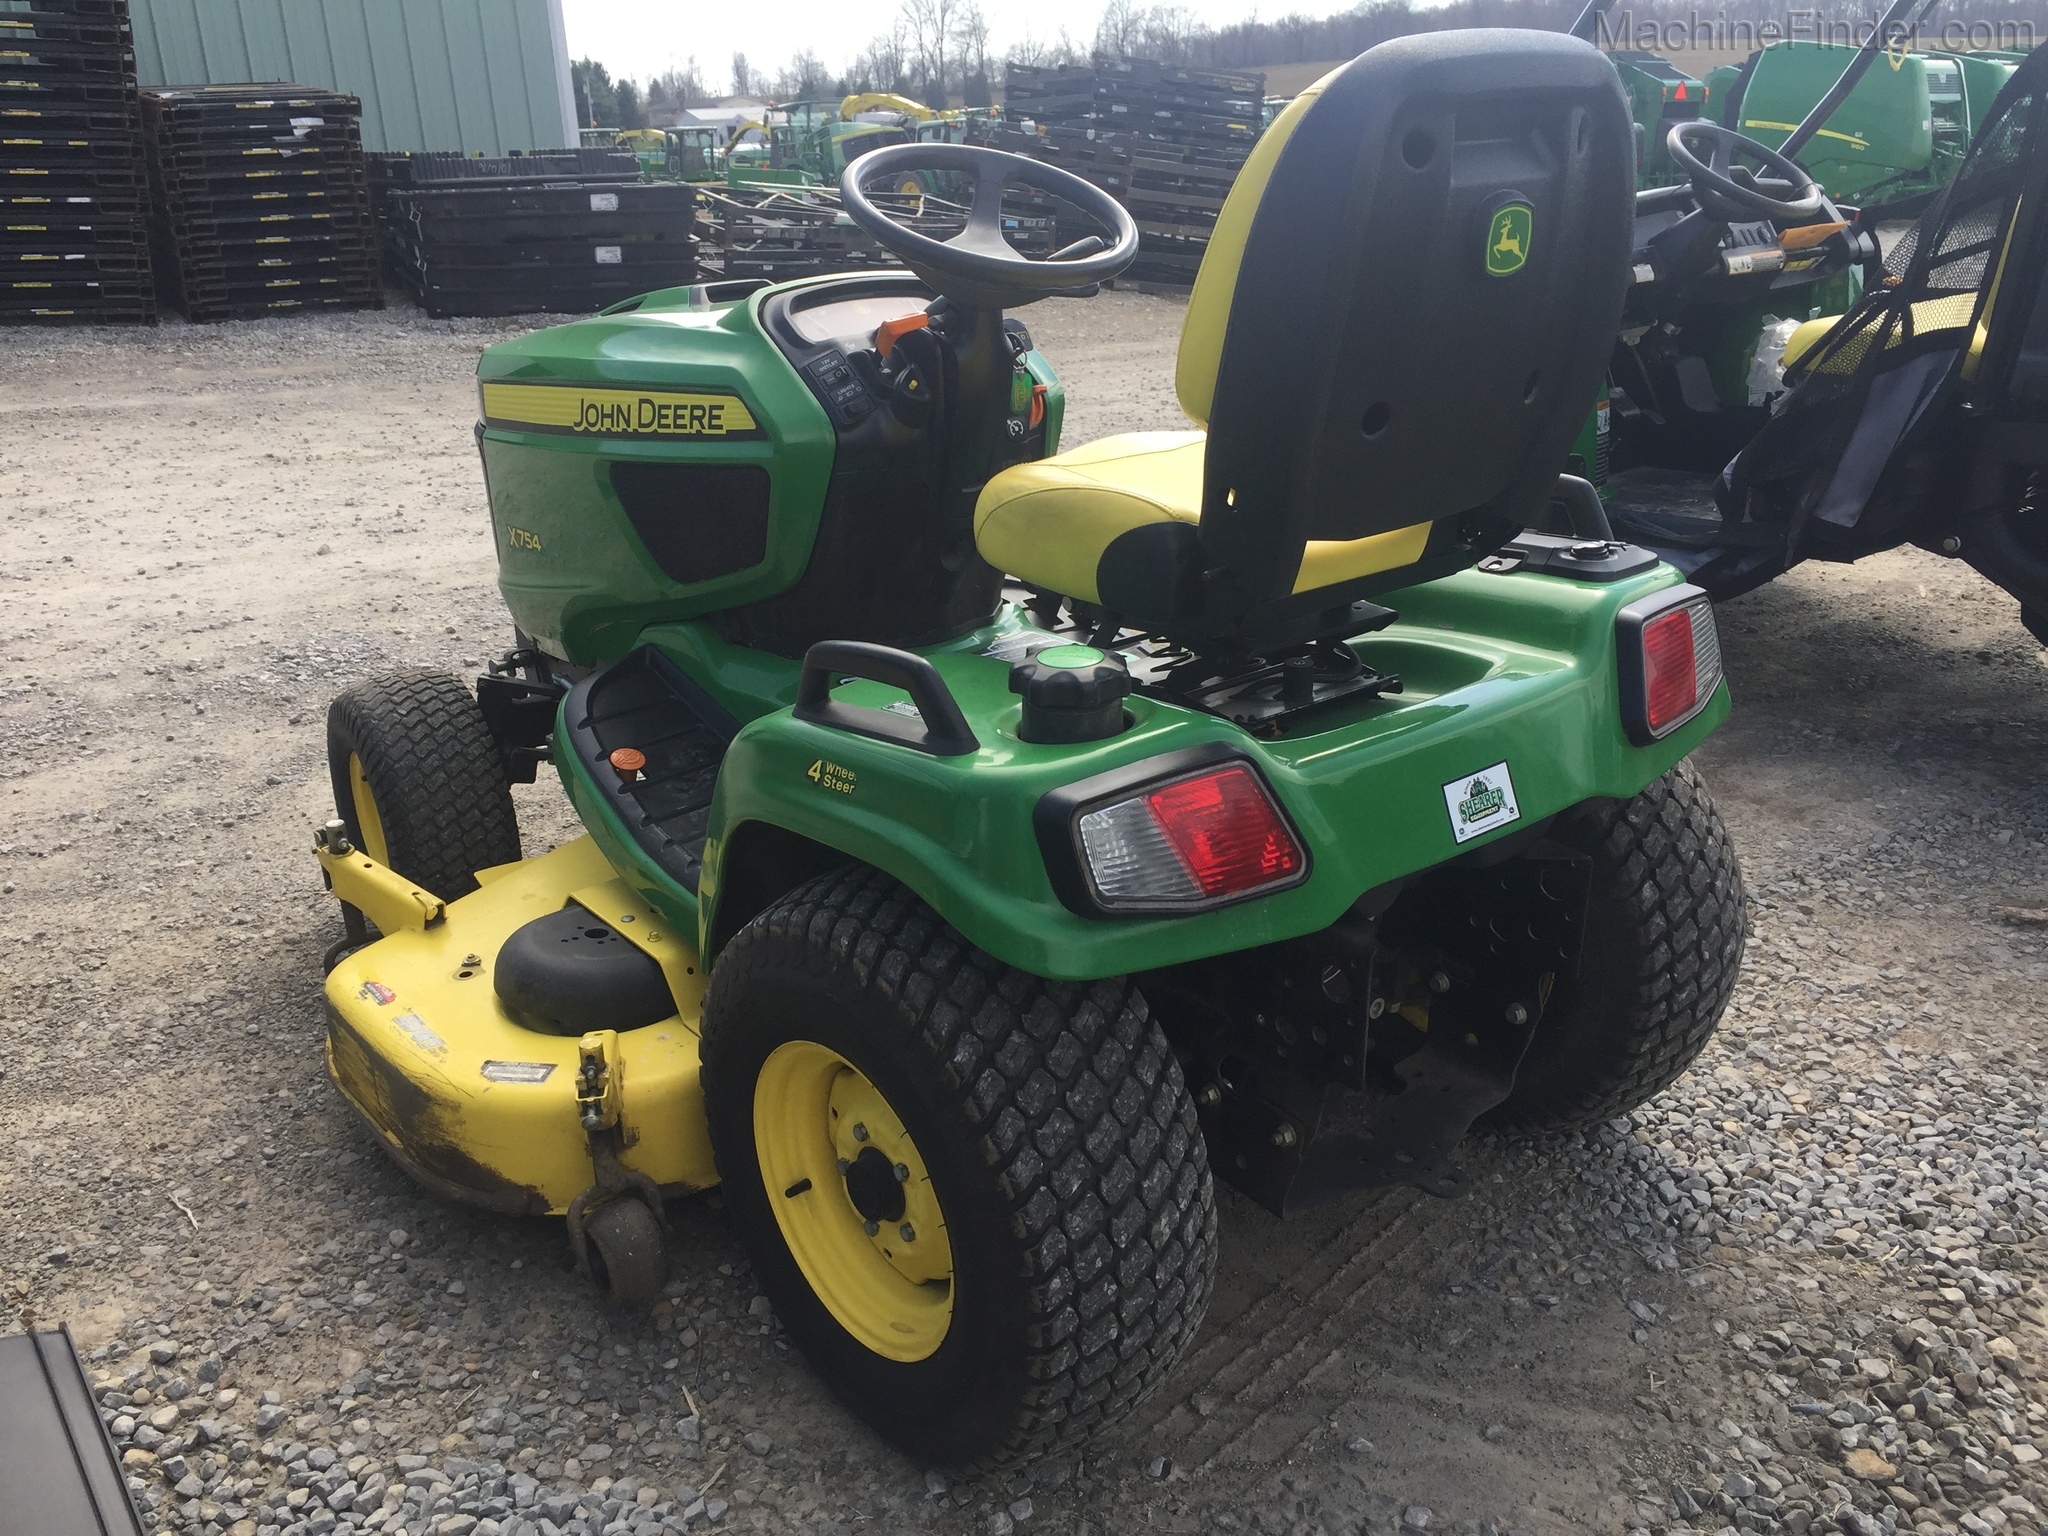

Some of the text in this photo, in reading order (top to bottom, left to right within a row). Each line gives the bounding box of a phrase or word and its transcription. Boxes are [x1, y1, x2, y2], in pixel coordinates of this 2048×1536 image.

[819, 360, 839, 372] OUTLET
[837, 384, 855, 395] LIGHTS
[573, 397, 725, 431] JOHN DEERE
[507, 525, 542, 552] X754
[807, 759, 822, 782] 4
[823, 774, 856, 795] Steer
[1458, 788, 1508, 824] SHEARER
